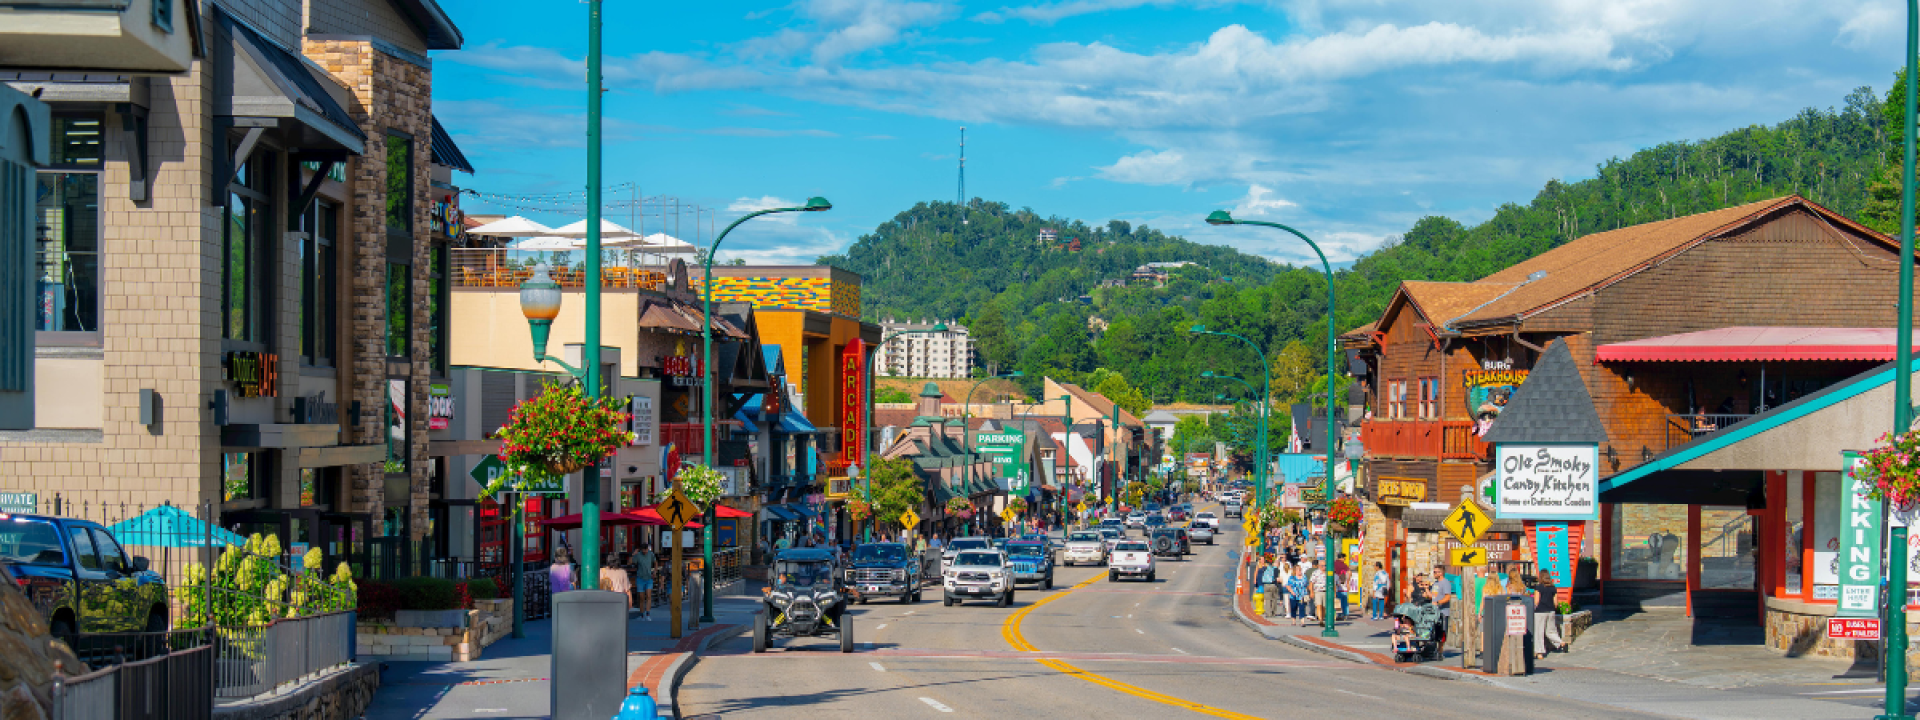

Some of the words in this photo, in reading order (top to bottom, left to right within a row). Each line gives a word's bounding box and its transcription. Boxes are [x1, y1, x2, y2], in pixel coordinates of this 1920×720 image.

[1484, 361, 1511, 370] BURG
[846, 357, 857, 460] ARCADE
[978, 434, 1023, 444] PARKING
[1504, 454, 1533, 474] Ole
[1534, 448, 1590, 479] Smoky
[1503, 476, 1540, 497] Candy
[1540, 473, 1589, 499] Kitchen
[1831, 623, 1843, 633] NO
